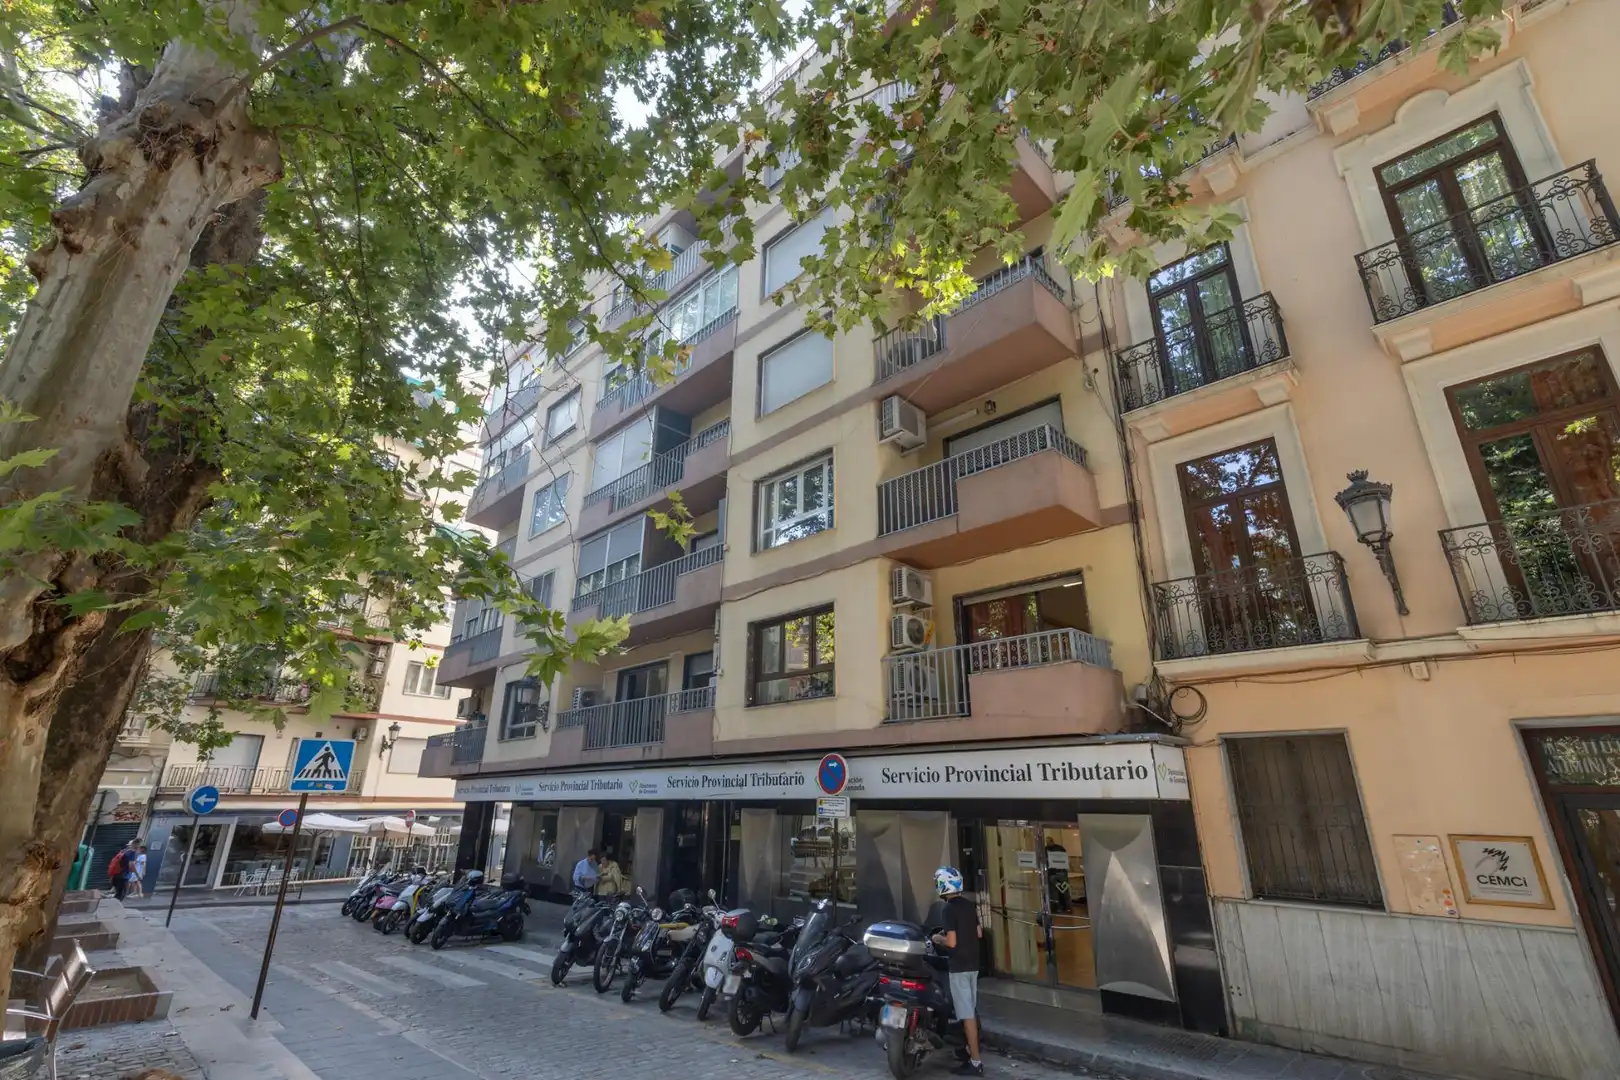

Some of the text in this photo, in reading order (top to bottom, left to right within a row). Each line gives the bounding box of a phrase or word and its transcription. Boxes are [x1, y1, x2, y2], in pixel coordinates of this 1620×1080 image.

[667, 772, 805, 788] Servicio Provincial Tributario
[881, 766, 940, 784] Servicio
[945, 762, 1032, 783] Provincial
[1037, 760, 1148, 781] Tributario
[538, 780, 559, 792] Servicio
[560, 779, 588, 791] Provincial
[590, 778, 623, 790] Tributario
